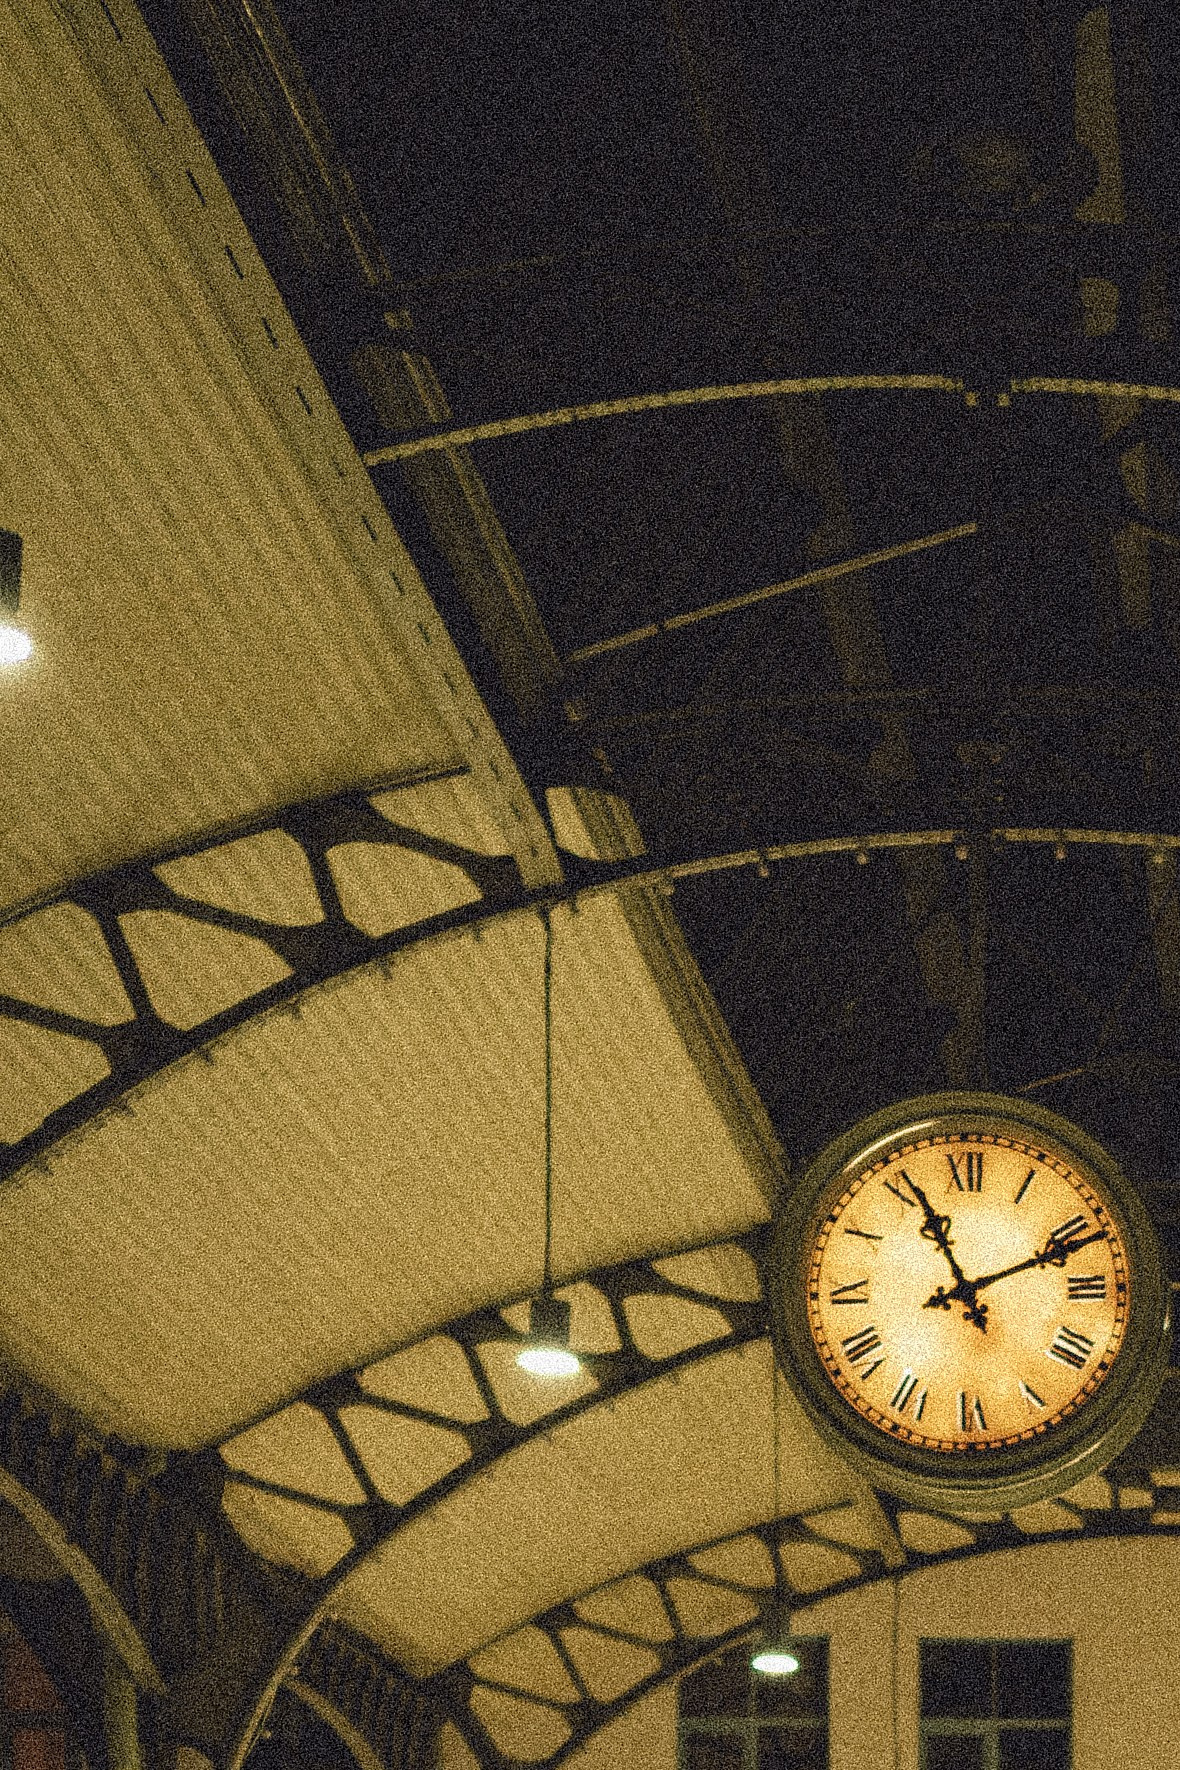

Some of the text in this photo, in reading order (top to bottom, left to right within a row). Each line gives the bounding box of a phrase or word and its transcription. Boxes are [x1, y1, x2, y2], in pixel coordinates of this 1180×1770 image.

[944, 1151, 983, 1193] XII
[1013, 1168, 1036, 1205] I
[1050, 1214, 1089, 1243] II
[829, 1275, 870, 1305] IX
[1067, 1275, 1106, 1300] III
[841, 1325, 886, 1381] VIII
[1050, 1325, 1095, 1370] IIII
[890, 1374, 928, 1422] VII
[961, 1391, 988, 1432] VI
